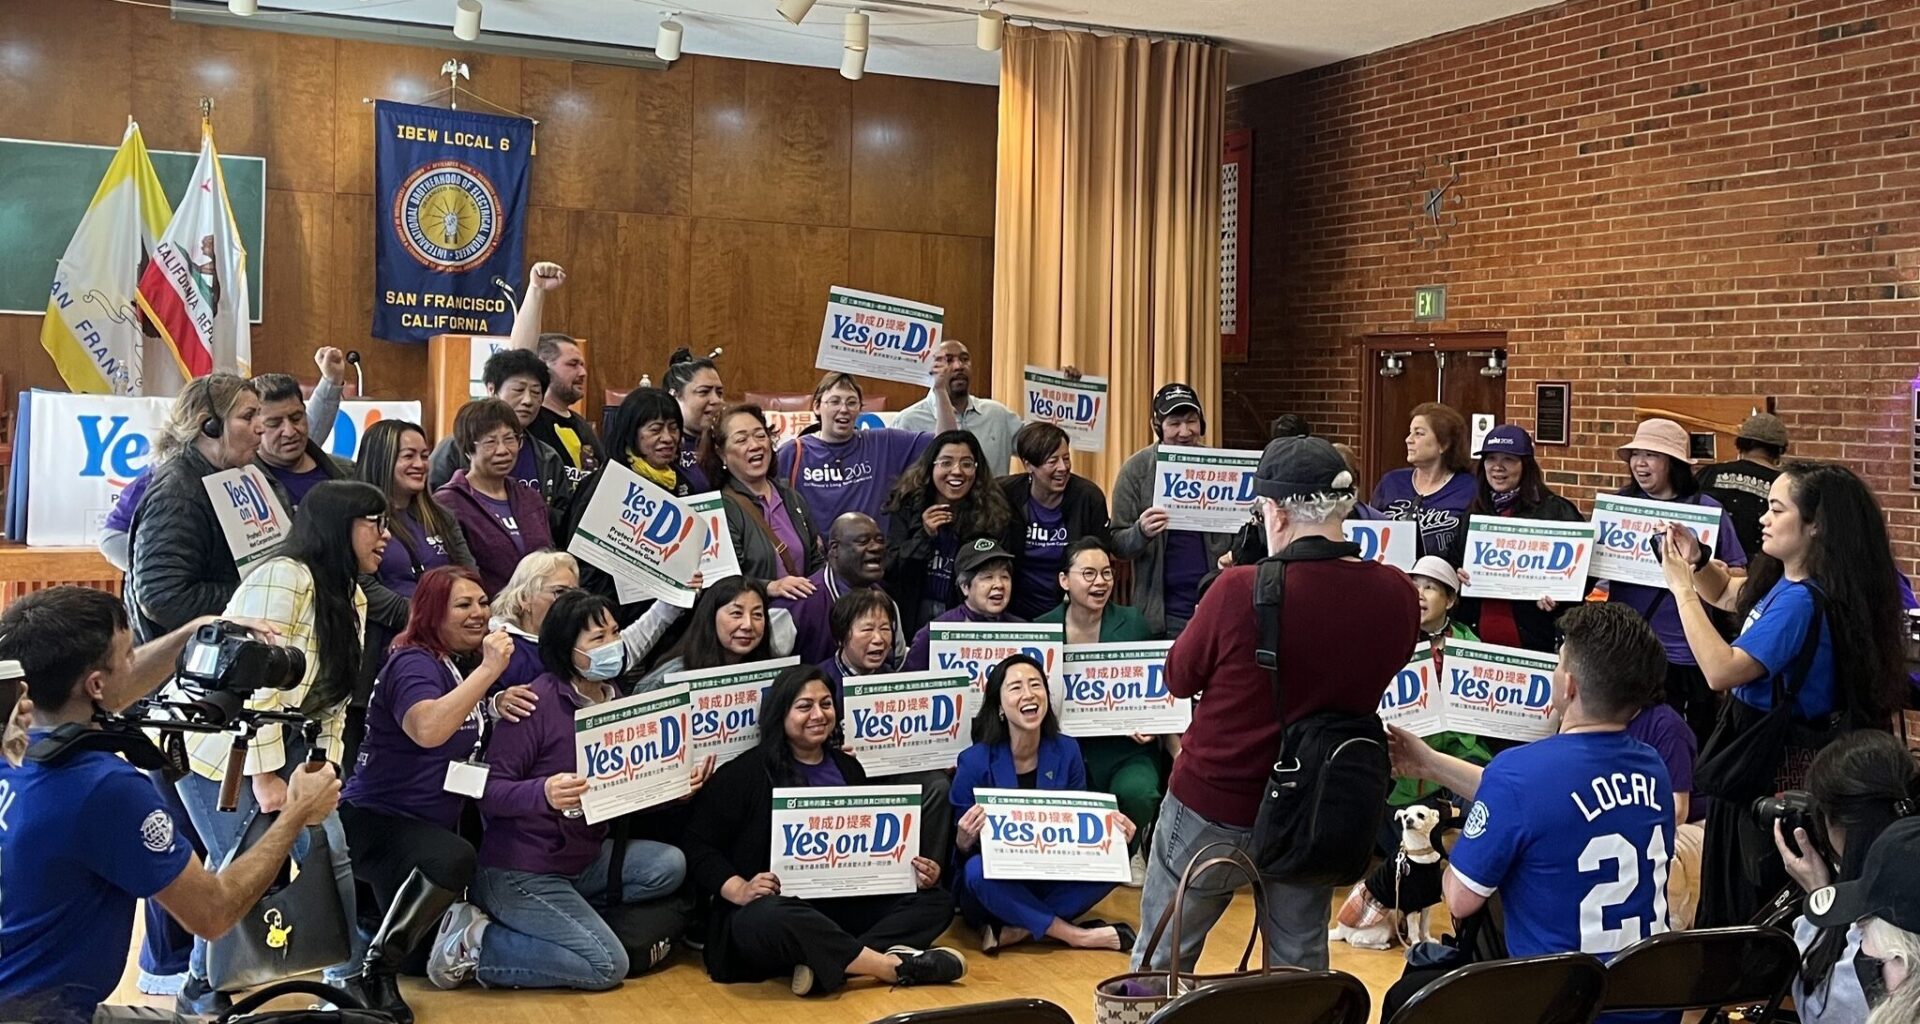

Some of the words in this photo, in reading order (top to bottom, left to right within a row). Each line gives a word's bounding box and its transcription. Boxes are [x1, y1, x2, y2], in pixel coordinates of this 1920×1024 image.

[397, 125, 438, 143] IBEW
[444, 131, 493, 150] LOCAL
[500, 138, 510, 151] 6
[410, 174, 461, 204] BROTHERHOOD
[461, 178, 472, 190] OF
[470, 187, 491, 232] ELECTRICAL
[407, 206, 447, 259] INTERNATIONAL
[455, 234, 487, 259] WORKERS
[156, 242, 200, 311] CALIFORNIA
[386, 291, 417, 306] SAN
[424, 294, 505, 312] FRANCISCO
[50, 281, 74, 309] AN
[75, 319, 118, 376] FRAN
[402, 314, 488, 332] CALIFORNIA
[831, 314, 869, 343] Yes
[874, 332, 900, 349] on
[902, 322, 936, 355] D!
[1029, 391, 1053, 416] Yes
[1057, 405, 1074, 420] on
[1076, 394, 1101, 425] D!
[77, 415, 149, 477] Ye
[804, 463, 843, 481] seiu
[1163, 473, 1201, 499] Yes
[1207, 485, 1234, 501] on
[1236, 472, 1257, 502] D
[223, 481, 250, 508] Yes
[240, 507, 252, 521] on
[622, 482, 656, 517] Yes
[622, 509, 639, 525] on
[643, 500, 694, 556] D!
[1027, 522, 1048, 541] eiu
[1050, 527, 1067, 541] 20
[607, 533, 617, 541] Not
[617, 540, 644, 557] Corporate
[644, 554, 660, 566] Greed
[610, 526, 634, 542] Protect
[640, 543, 655, 555] Care
[1352, 527, 1390, 561] D!
[1597, 521, 1636, 549] Yes
[1473, 541, 1511, 566] Yes
[1517, 554, 1544, 569] on
[1547, 542, 1585, 570] D!
[1063, 674, 1105, 701] Yes
[1112, 682, 1142, 699] on
[1145, 665, 1168, 698] D
[1382, 691, 1395, 709] n
[1396, 666, 1428, 705] D!
[1450, 668, 1489, 699] Yes
[1495, 686, 1523, 704] on
[1525, 675, 1551, 707] D
[691, 706, 719, 735] es
[727, 708, 756, 731] on
[852, 709, 893, 738] Yes
[900, 715, 928, 734] on
[930, 694, 962, 732] D!
[584, 742, 624, 777] Yes
[631, 741, 658, 765] on
[660, 713, 686, 758] D!
[1571, 773, 1661, 822] LOCAL
[782, 824, 829, 856] Yes
[836, 834, 868, 854] on
[870, 813, 912, 852] D!
[987, 815, 1034, 841] Yes
[1042, 826, 1074, 843] on
[1077, 812, 1113, 844] D!
[1578, 825, 1671, 953] 21
[1108, 1010, 1121, 1020] MK
[1139, 1012, 1153, 1021] MK
[1123, 1001, 1138, 1012] MK
